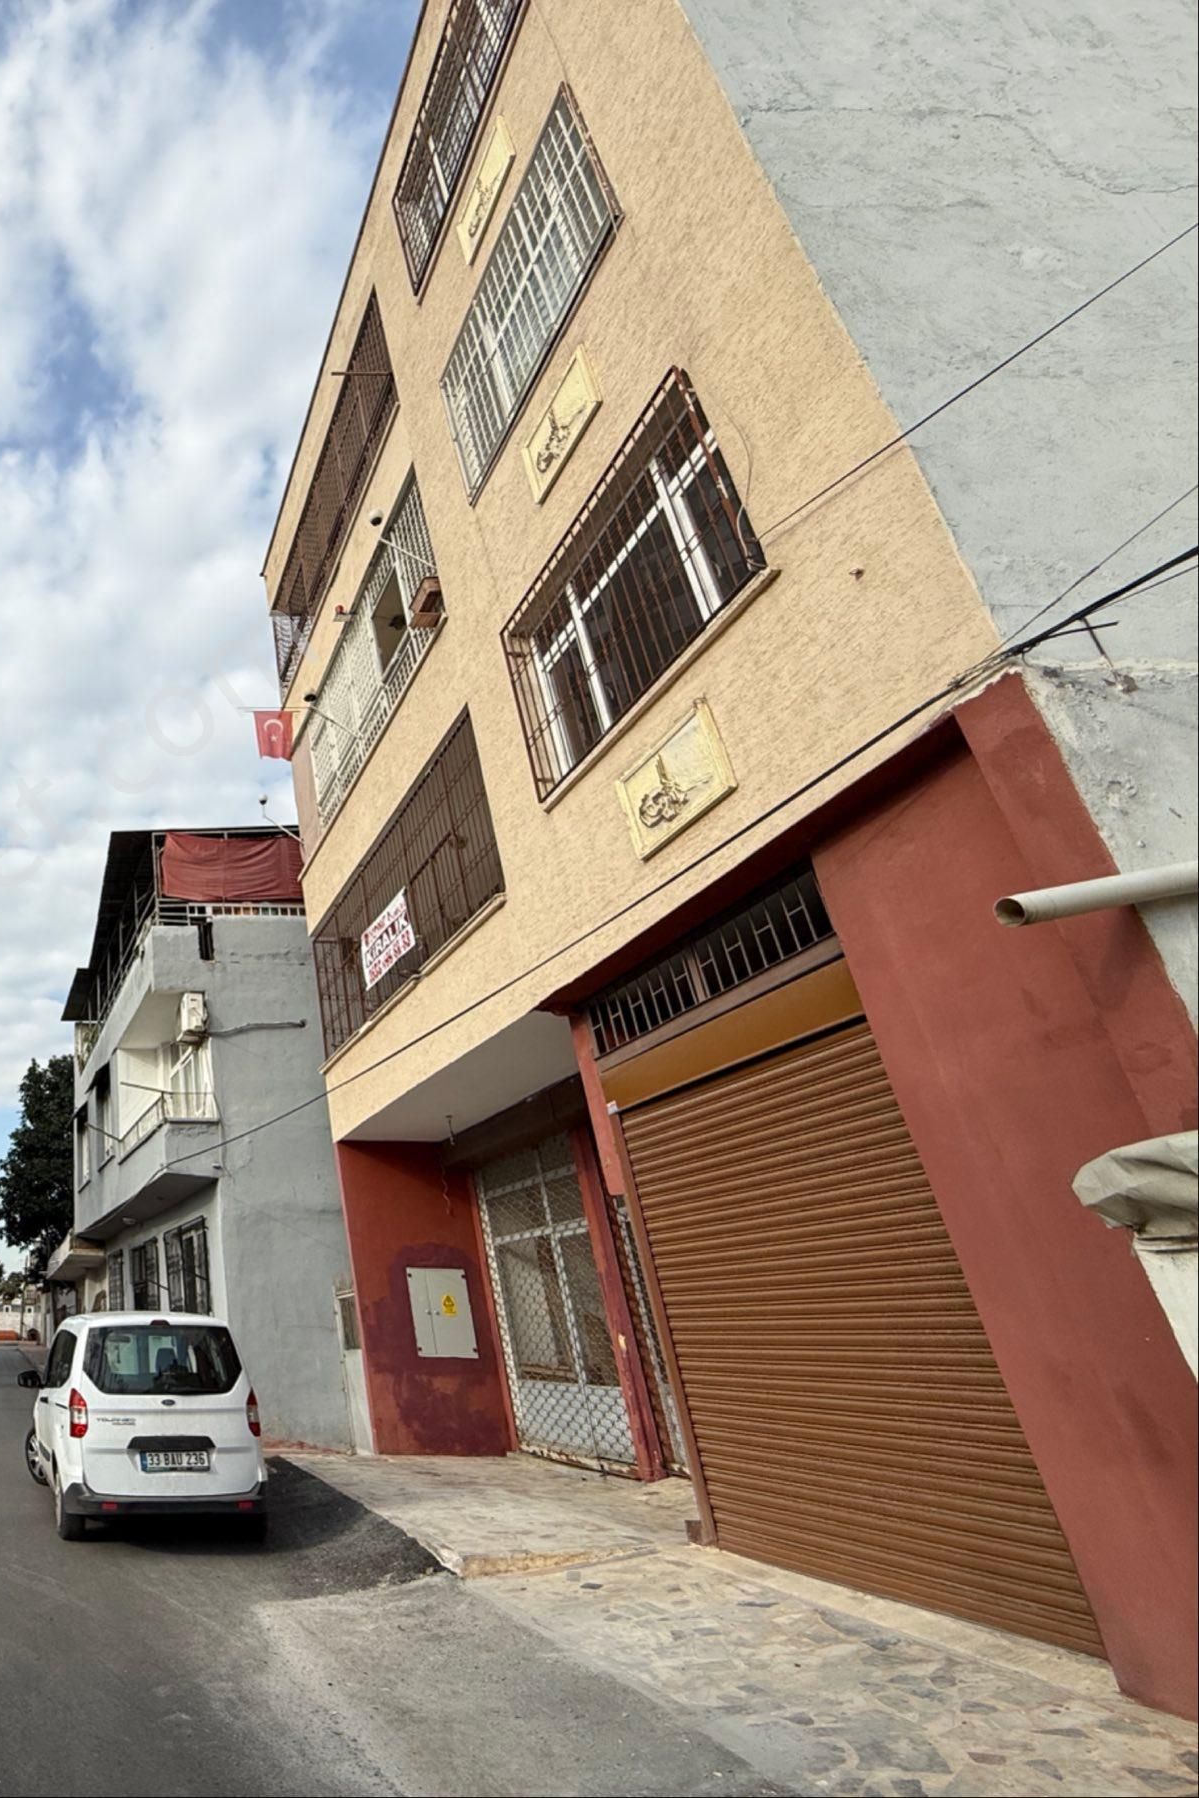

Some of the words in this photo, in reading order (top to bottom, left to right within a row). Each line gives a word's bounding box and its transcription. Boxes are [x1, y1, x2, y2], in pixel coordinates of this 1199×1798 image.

[147, 1453, 160, 1466] 33
[164, 1453, 183, 1466] BAU
[186, 1453, 205, 1465] 236
